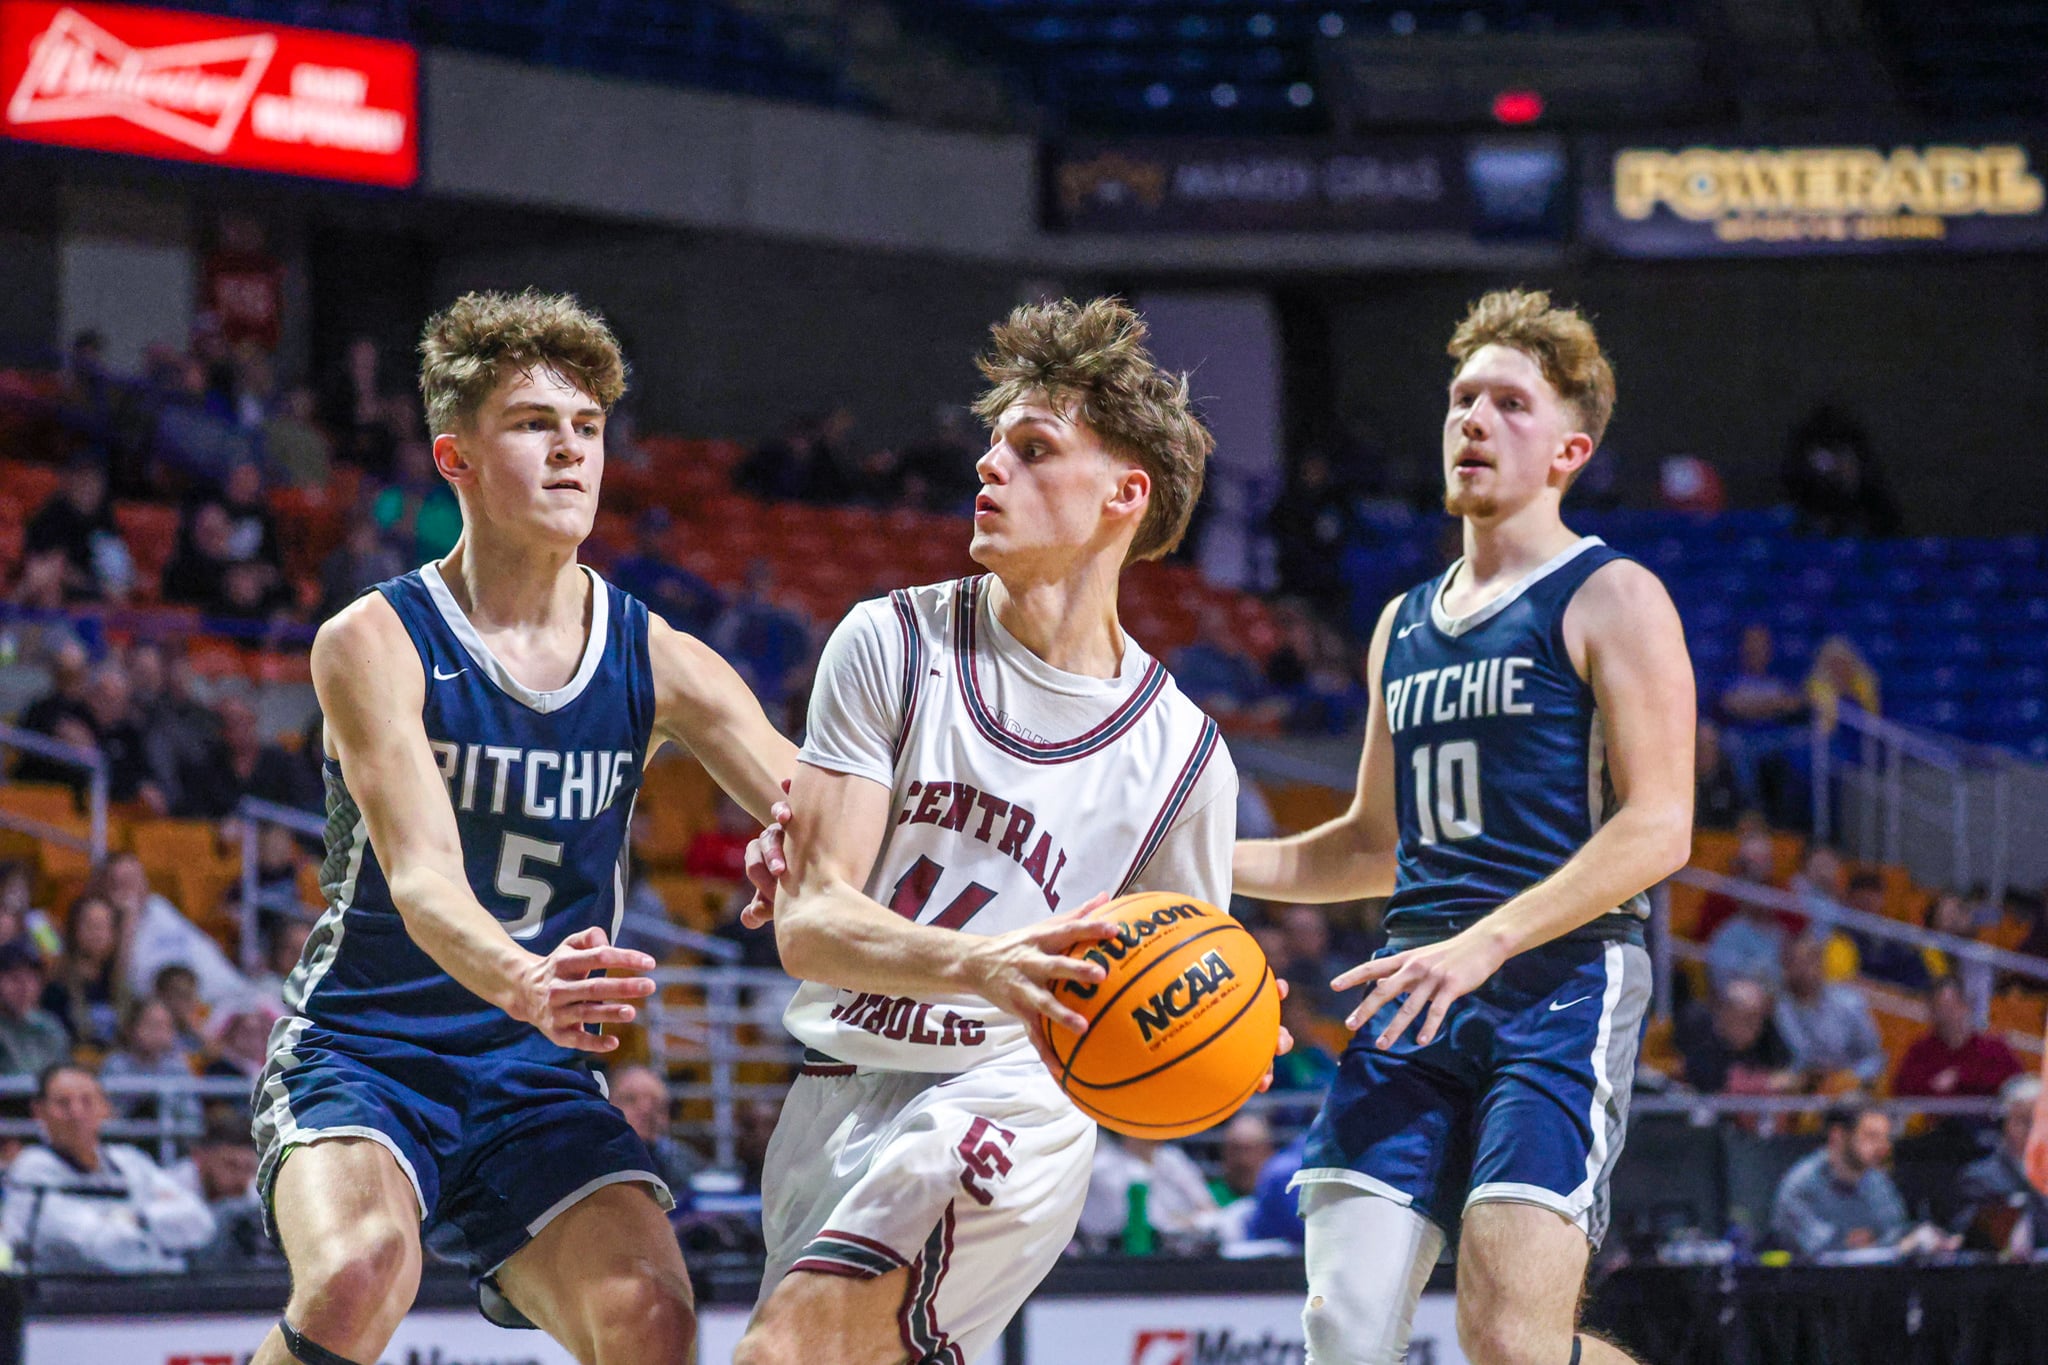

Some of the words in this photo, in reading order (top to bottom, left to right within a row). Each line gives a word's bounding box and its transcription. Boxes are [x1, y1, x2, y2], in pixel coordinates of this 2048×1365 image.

[1386, 657, 1533, 735] RITCHIE
[1411, 739, 1483, 846] 10
[494, 829, 565, 940] 5
[898, 780, 1067, 913] CENTRAL
[1131, 948, 1236, 1043] NCAA
[1193, 997, 1219, 1020] GAME
